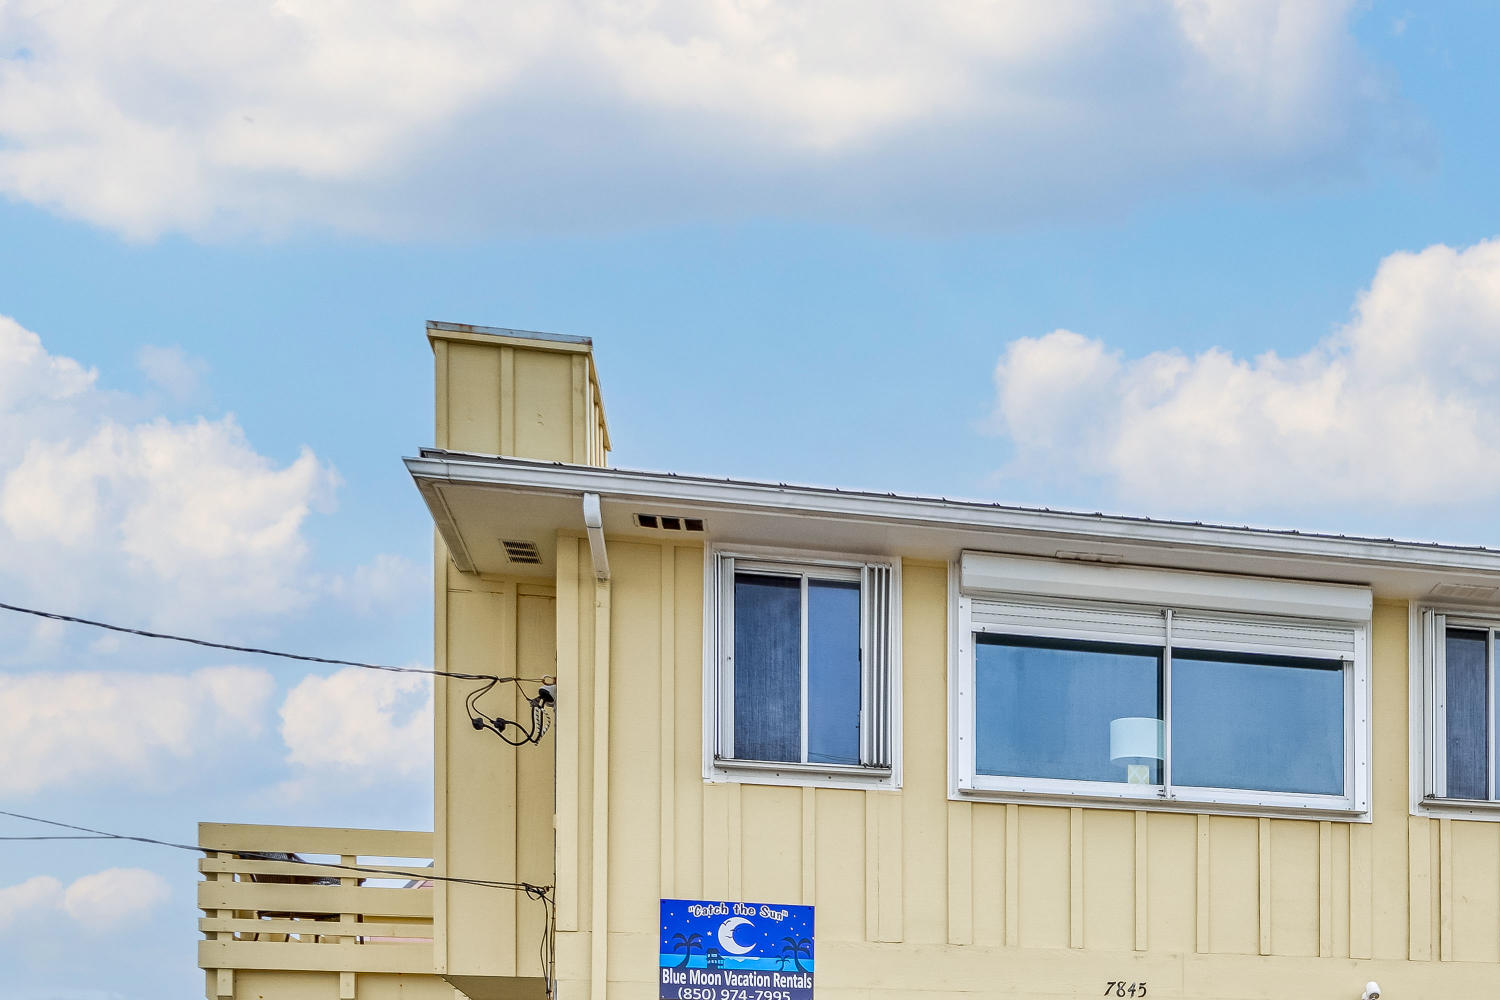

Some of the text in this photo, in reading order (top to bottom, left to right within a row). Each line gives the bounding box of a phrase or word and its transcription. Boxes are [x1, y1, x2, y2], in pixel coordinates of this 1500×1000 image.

[688, 902, 788, 921] "Catch the Sun"
[662, 968, 812, 989] Blue Moon Vacation Rentals
[677, 987, 716, 1000] (850)
[1104, 981, 1147, 999] 7845
